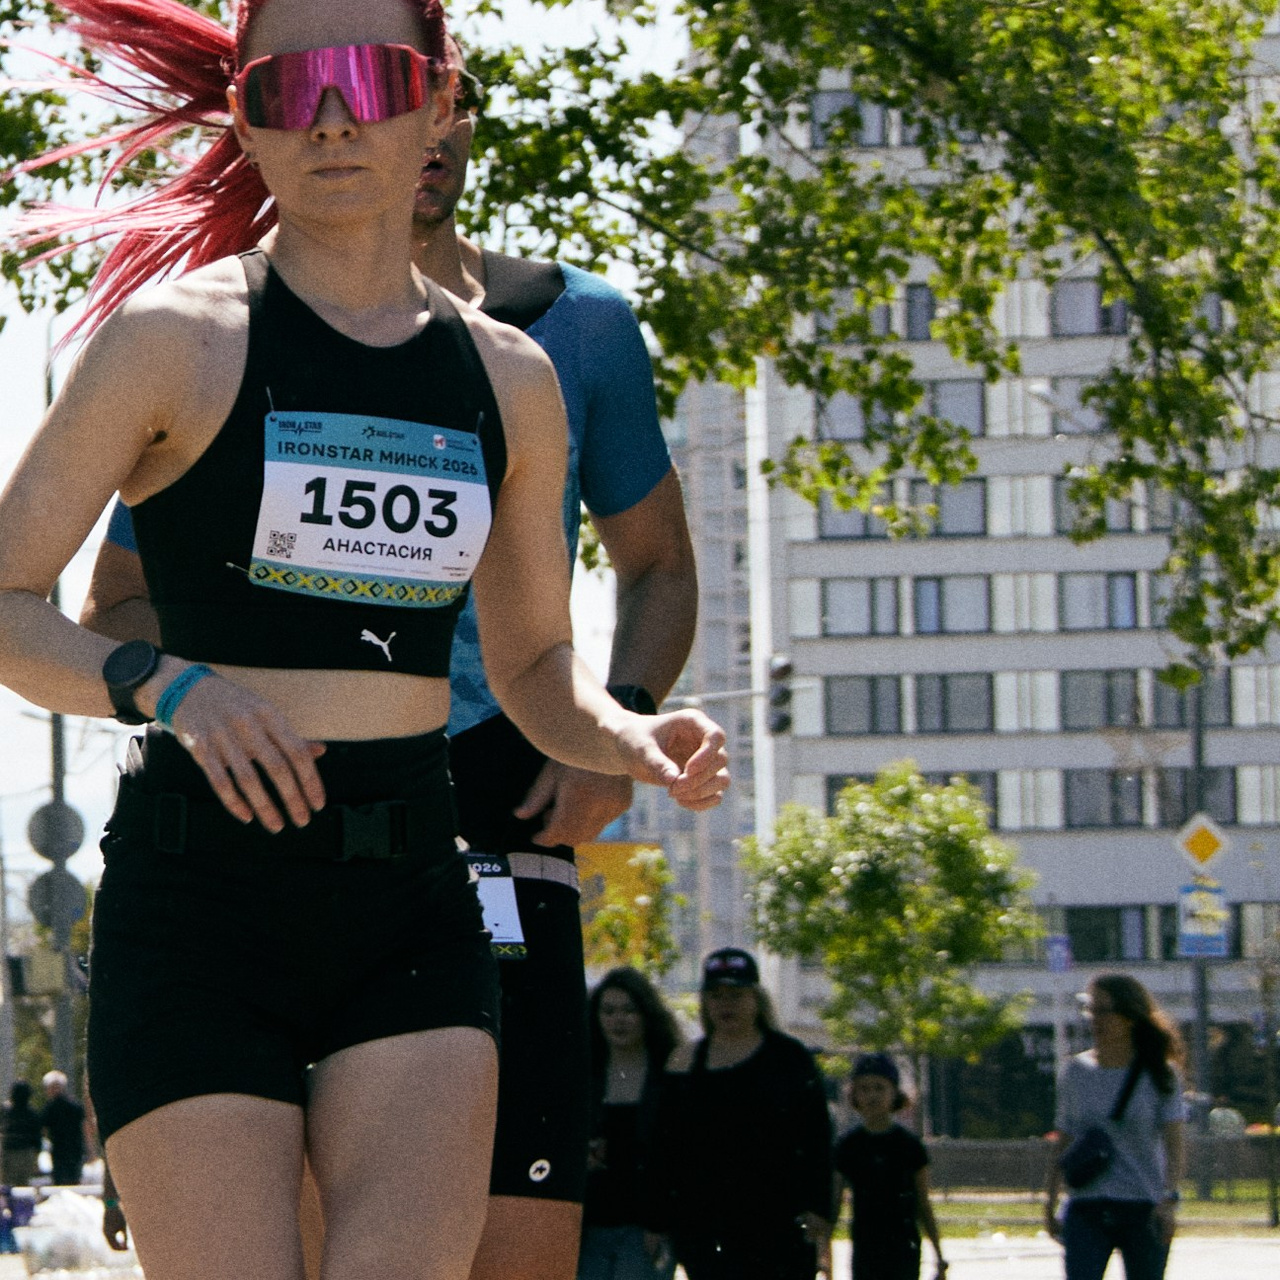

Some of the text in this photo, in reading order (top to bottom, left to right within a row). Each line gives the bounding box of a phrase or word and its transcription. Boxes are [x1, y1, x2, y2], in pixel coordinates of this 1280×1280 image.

[277, 440, 374, 463] IRONSTAR
[379, 447, 438, 471] МИНСК
[299, 476, 459, 538] 1503
[322, 538, 433, 562] АНАСТАСИЯ
[472, 862, 502, 873] 026
